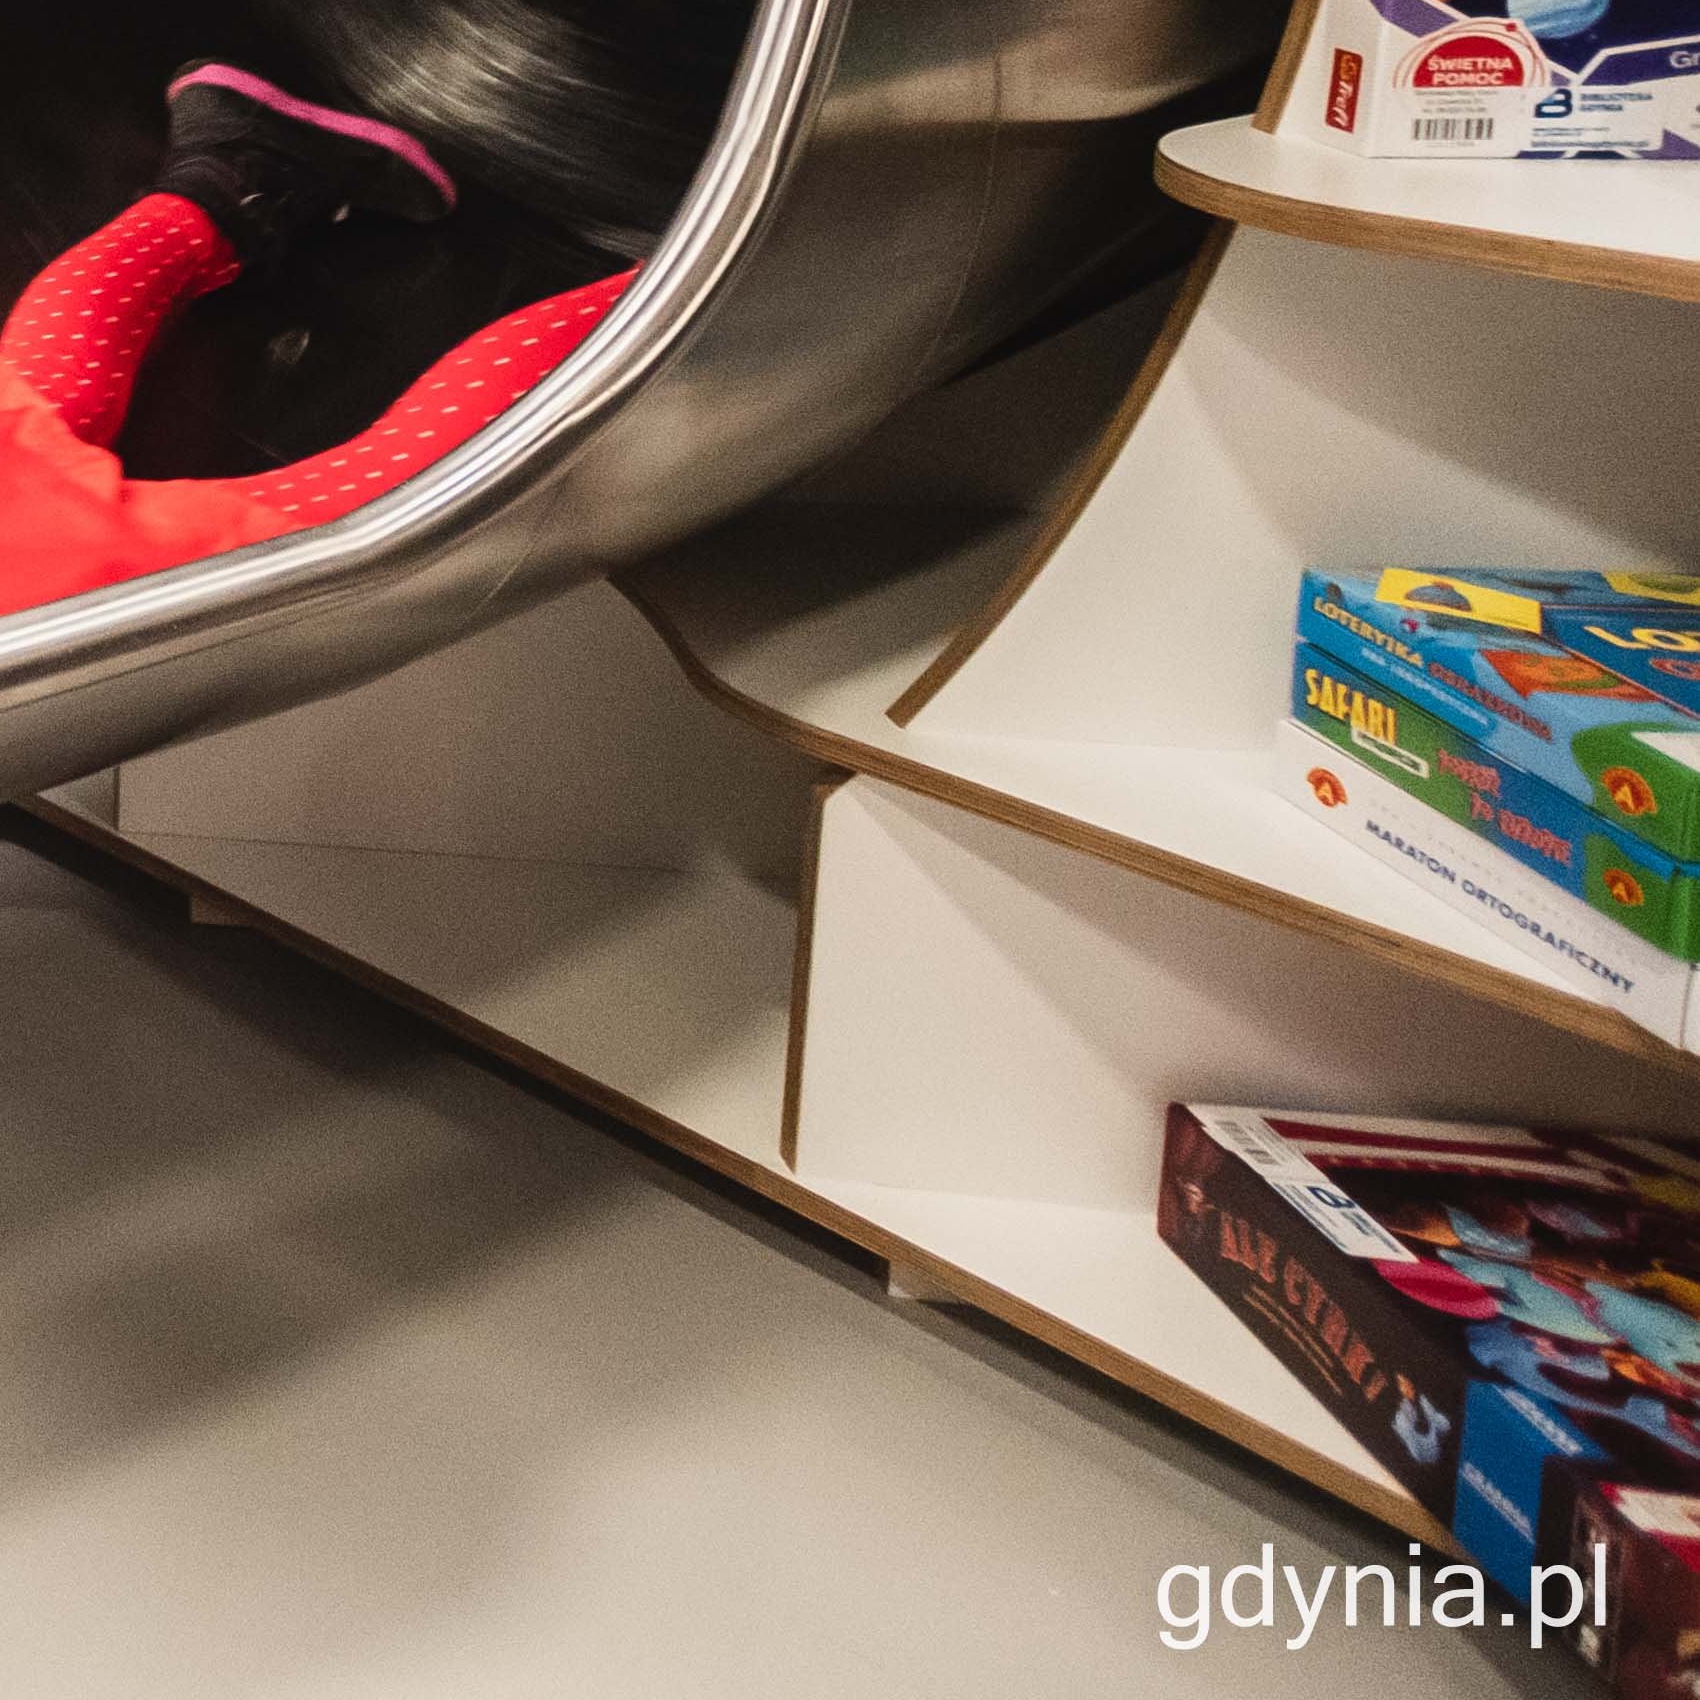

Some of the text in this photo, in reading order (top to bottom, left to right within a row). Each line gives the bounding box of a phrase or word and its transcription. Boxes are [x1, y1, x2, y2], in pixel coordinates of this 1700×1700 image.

[1428, 54, 1514, 71] ŚWIETNA
[1431, 72, 1505, 86] POMOC
[1304, 668, 1397, 746] SAFARI
[1365, 819, 1456, 885] MARATON
[1462, 878, 1636, 993] ORTOGRAFICZNY
